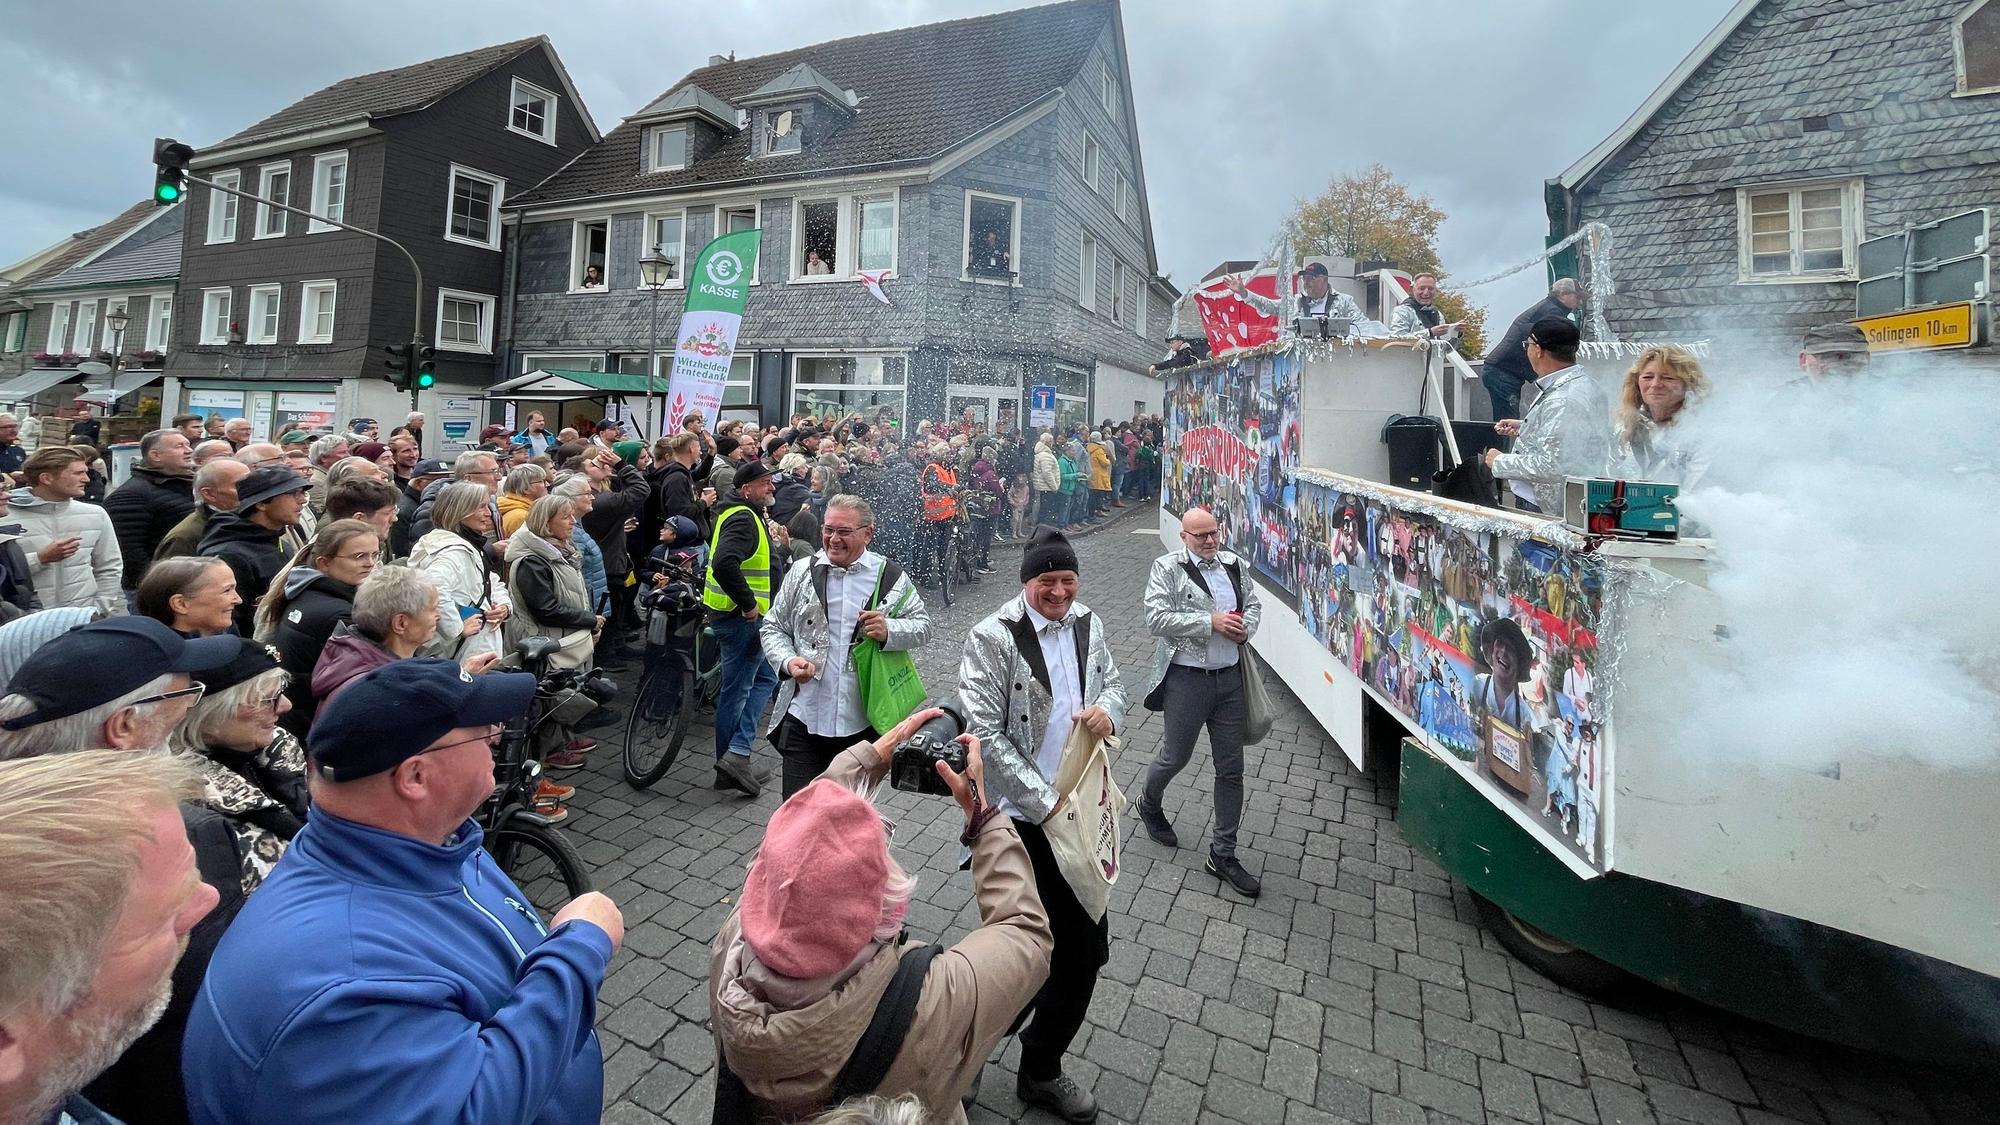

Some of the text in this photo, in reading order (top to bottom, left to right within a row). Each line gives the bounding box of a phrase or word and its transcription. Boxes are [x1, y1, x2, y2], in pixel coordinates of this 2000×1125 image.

[700, 283, 740, 299] KASSE
[1869, 320, 1958, 343] Solingen 10 km
[677, 356, 728, 373] Witzhelden
[676, 366, 727, 381] Erntedank
